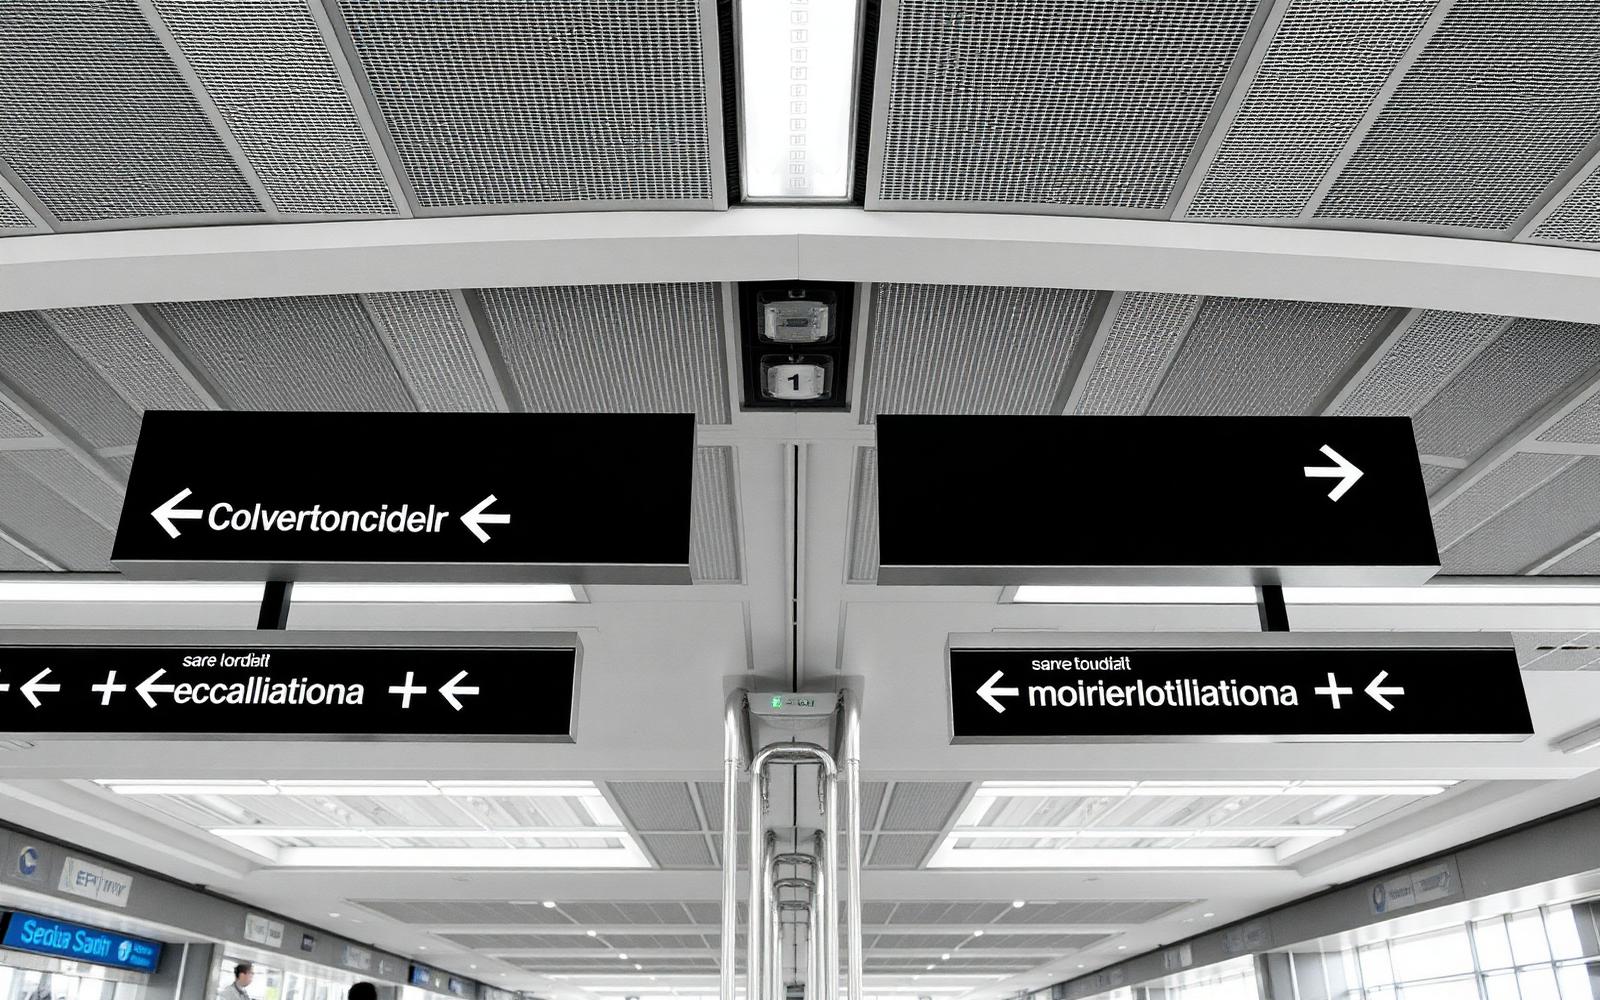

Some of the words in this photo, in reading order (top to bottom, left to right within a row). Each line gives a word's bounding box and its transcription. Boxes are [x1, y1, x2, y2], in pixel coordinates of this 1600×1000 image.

[787, 373, 800, 391] 1
[208, 502, 449, 533] Colvertoncidelr
[182, 655, 217, 668] sare
[173, 676, 365, 705] eccalliationa
[1028, 678, 1299, 707] moirierlotiliationa
